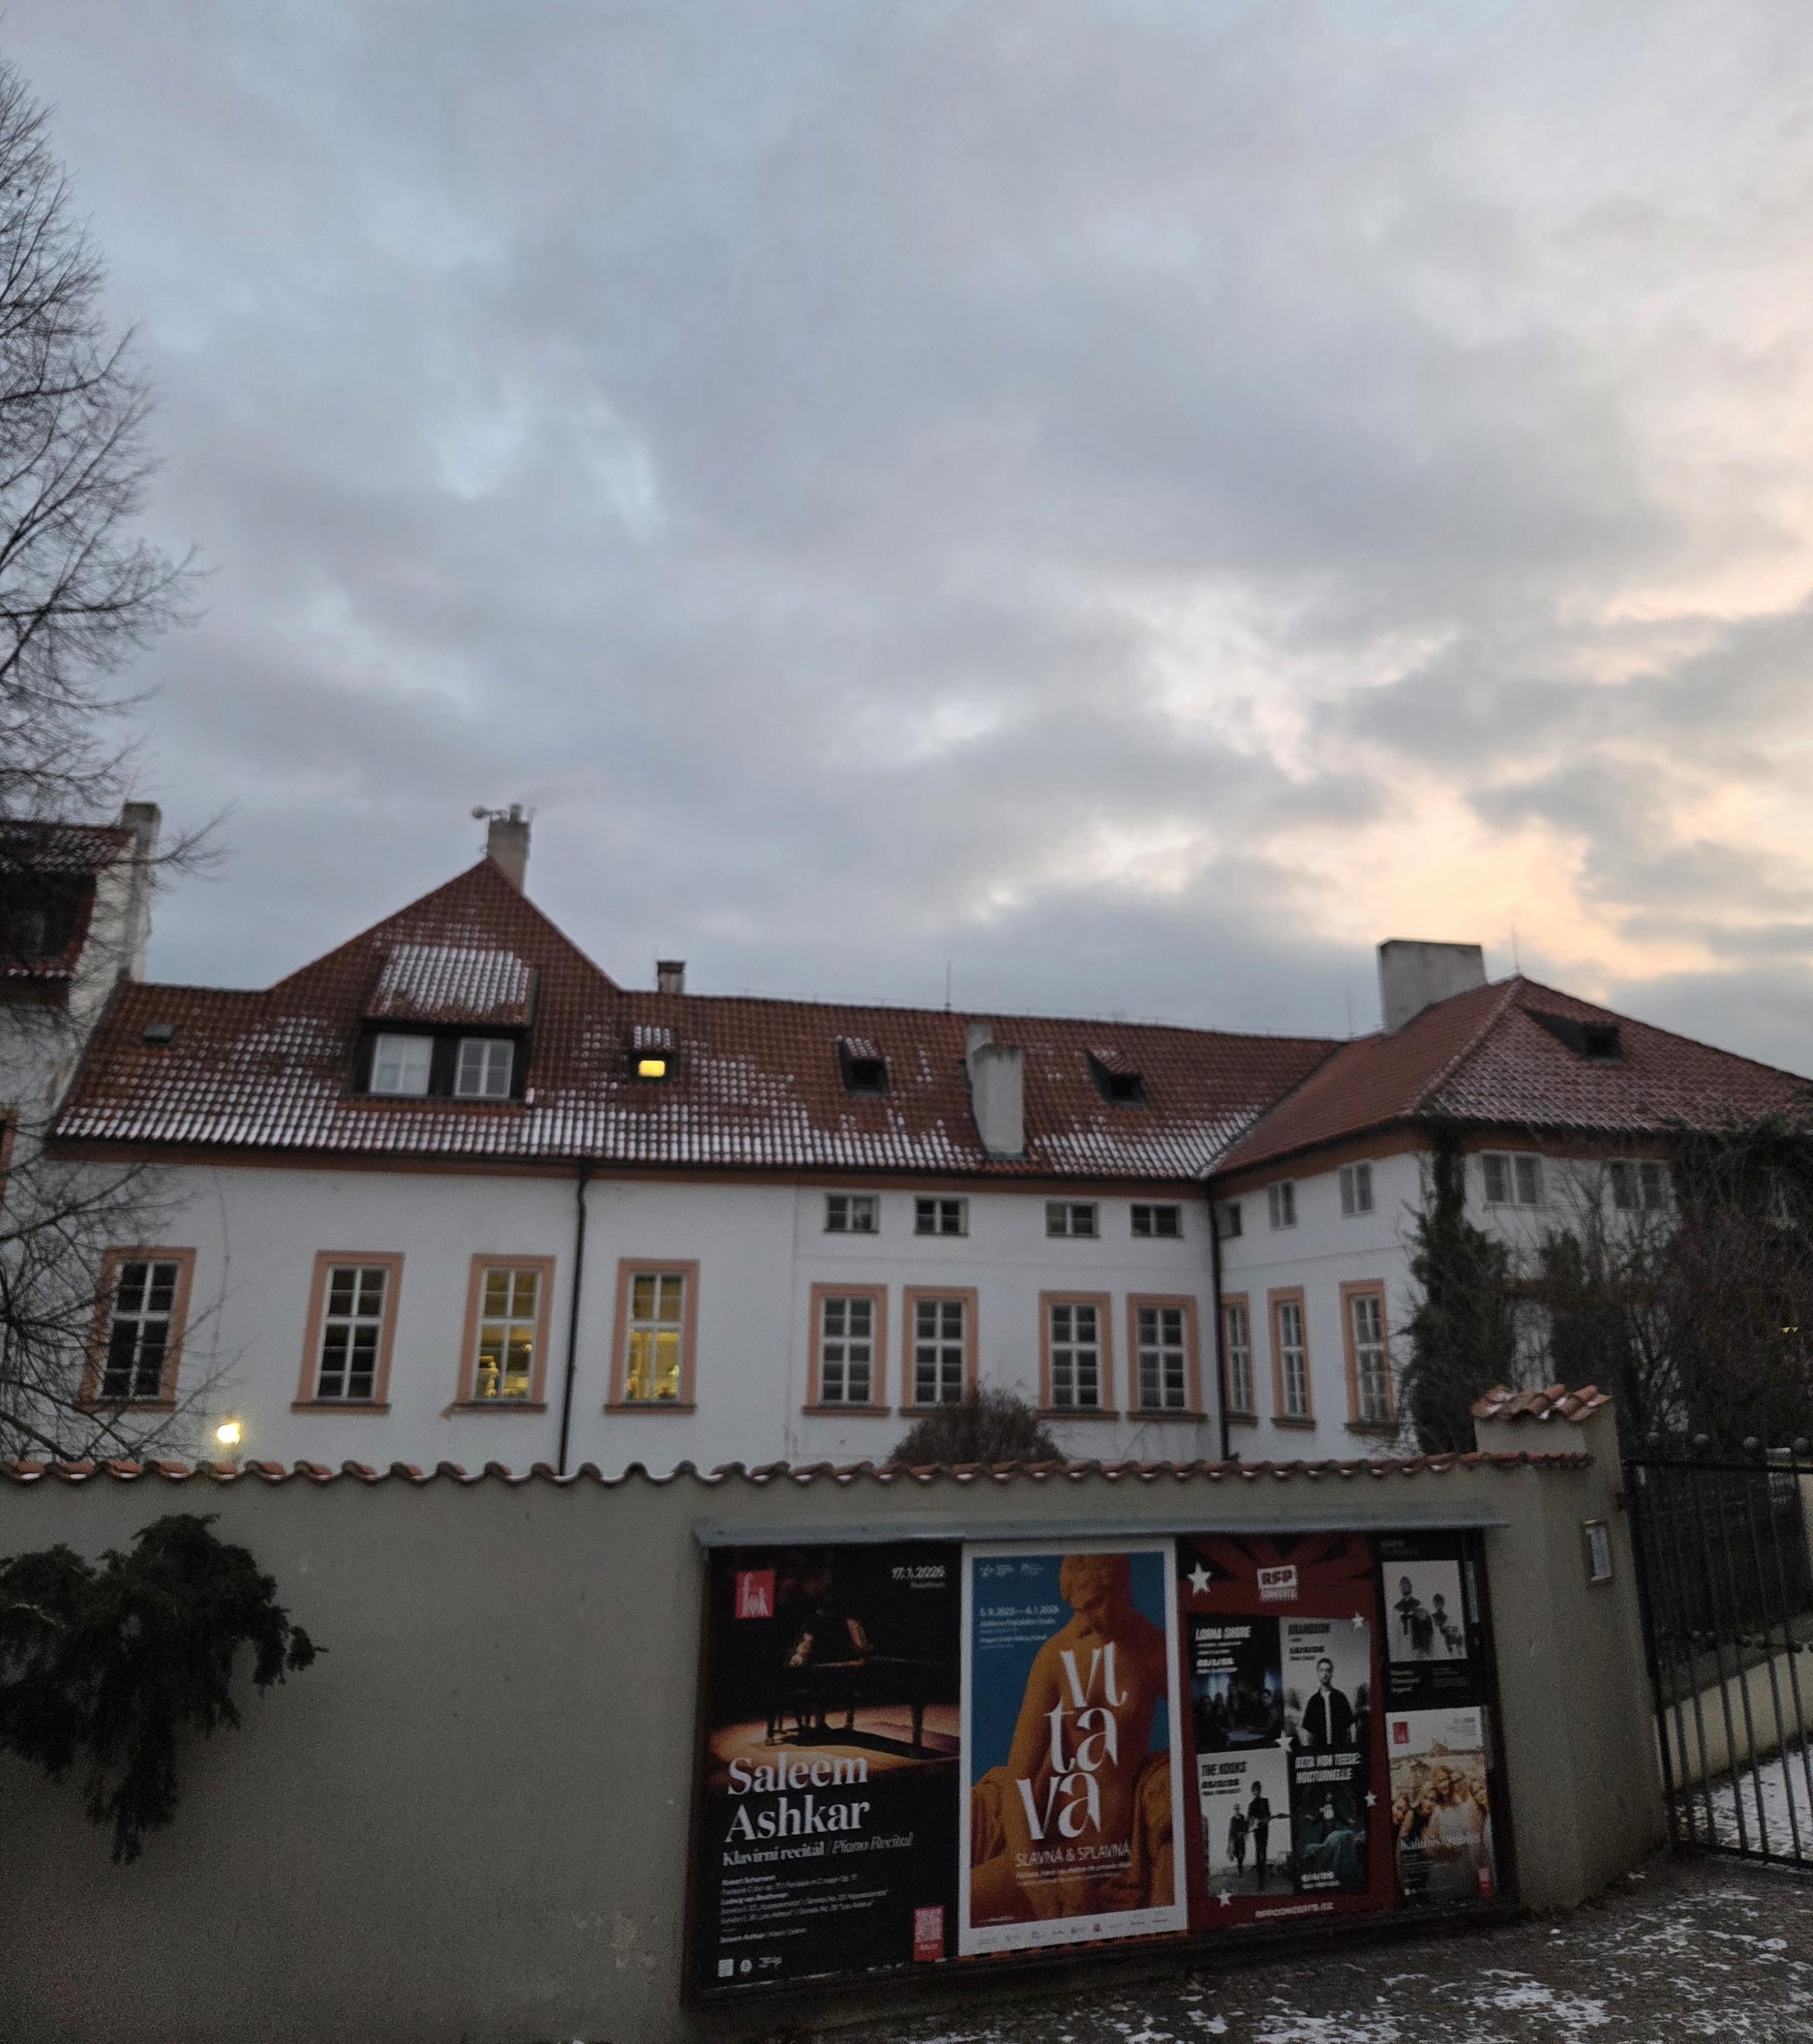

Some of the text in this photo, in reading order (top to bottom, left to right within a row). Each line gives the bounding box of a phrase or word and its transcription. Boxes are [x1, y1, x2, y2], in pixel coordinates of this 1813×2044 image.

[1042, 1694, 1117, 1773] ta
[728, 1752, 869, 1795] Saleem
[1202, 1763, 1218, 1777] THE
[724, 1795, 871, 1843] Ashkar
[833, 1837, 869, 1854] Piano
[1065, 1848, 1076, 1861] &
